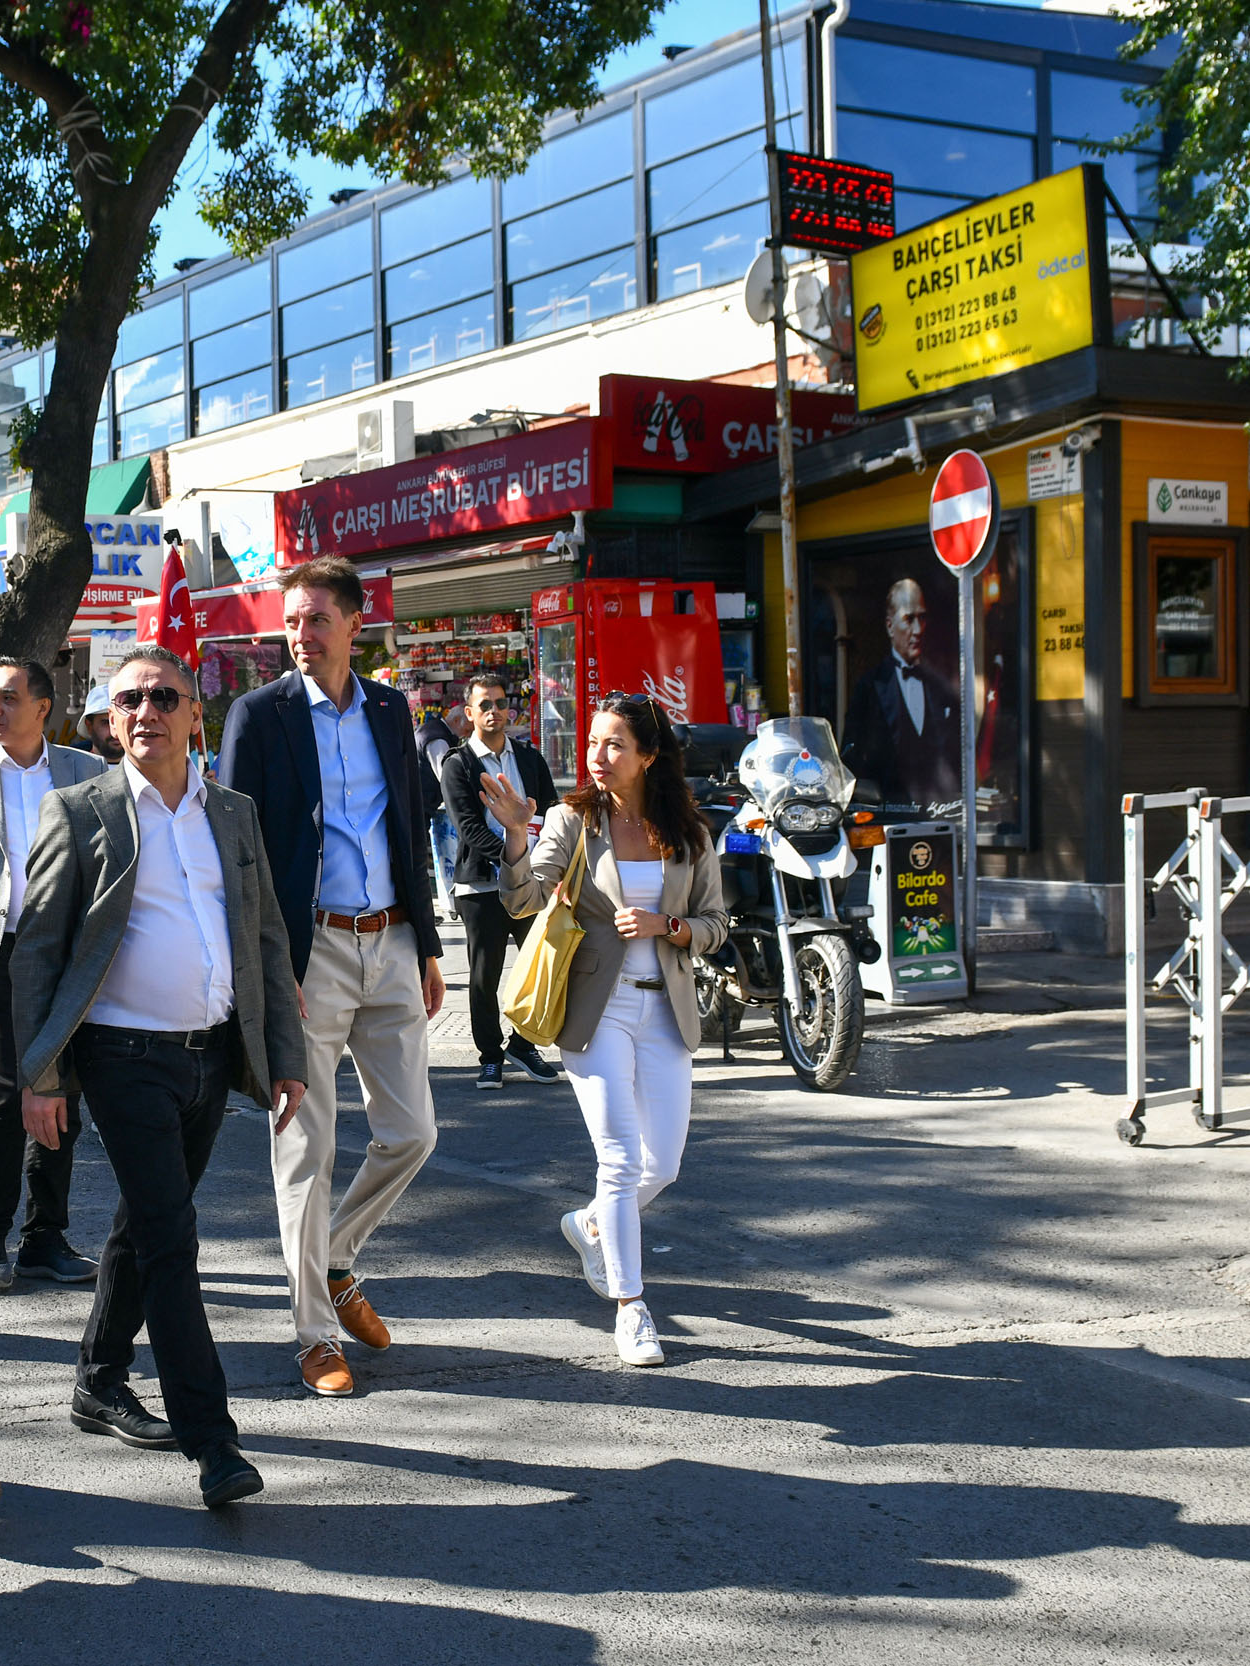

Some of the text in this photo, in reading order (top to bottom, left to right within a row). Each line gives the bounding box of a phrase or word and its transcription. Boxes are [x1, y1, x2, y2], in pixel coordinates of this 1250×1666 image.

[893, 201, 1035, 272] BAHÇELİEVLER
[907, 234, 1023, 306] ÇARŞI TAKSİ
[915, 286, 1017, 331] 0 (312) 223 88 48
[916, 308, 1018, 352] 0 (312) 223 65 63
[396, 476, 427, 492] ANKARA
[477, 453, 507, 478] BÜFESİ
[332, 505, 385, 543] ÇARŞI
[391, 476, 501, 526] MEŞRUBAT
[506, 448, 589, 502] BÜFESİ
[93, 553, 143, 577] LIK
[126, 588, 145, 602] EVİ
[897, 869, 946, 889] Bilardo
[905, 889, 939, 907] Cafe
